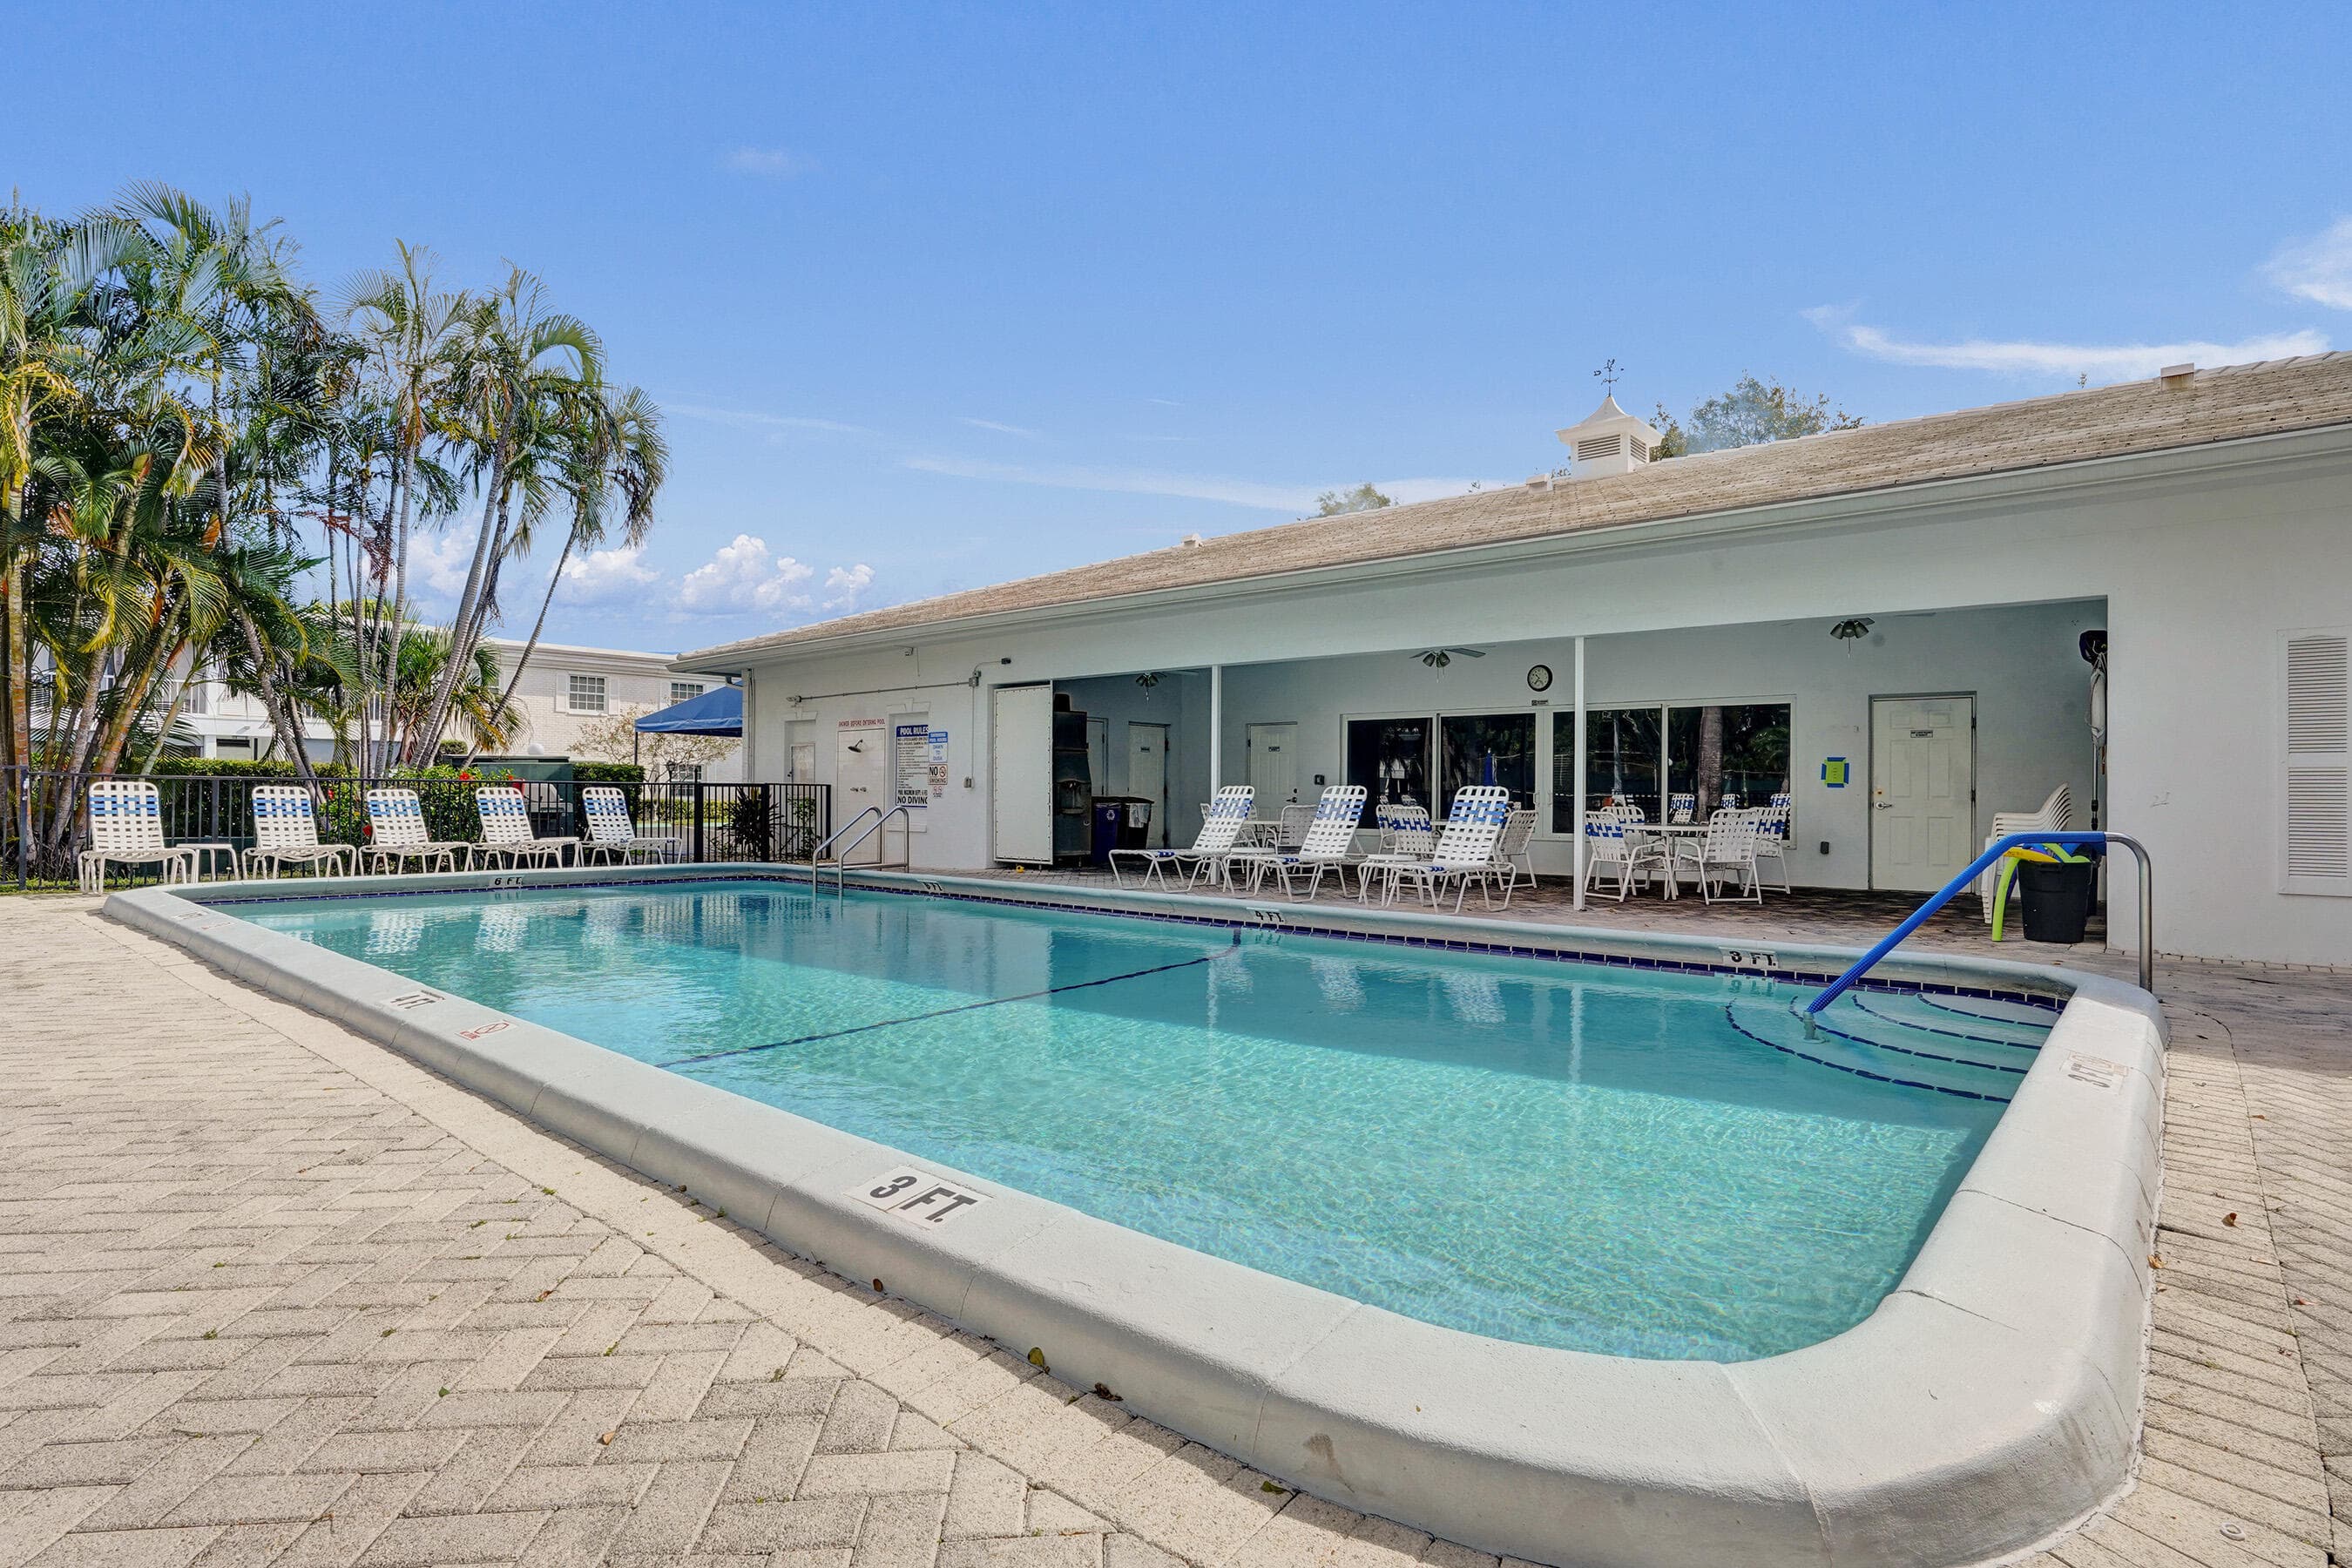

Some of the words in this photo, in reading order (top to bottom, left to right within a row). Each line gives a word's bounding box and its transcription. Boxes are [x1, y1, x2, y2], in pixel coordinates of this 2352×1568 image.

[900, 727, 913, 735] POOL
[929, 766, 938, 775] NO
[1254, 910, 1264, 920] 4
[1728, 950, 1742, 963] 3
[1749, 952, 1776, 966] FT.
[869, 1175, 917, 1199] 3
[899, 1186, 978, 1223] FT.
